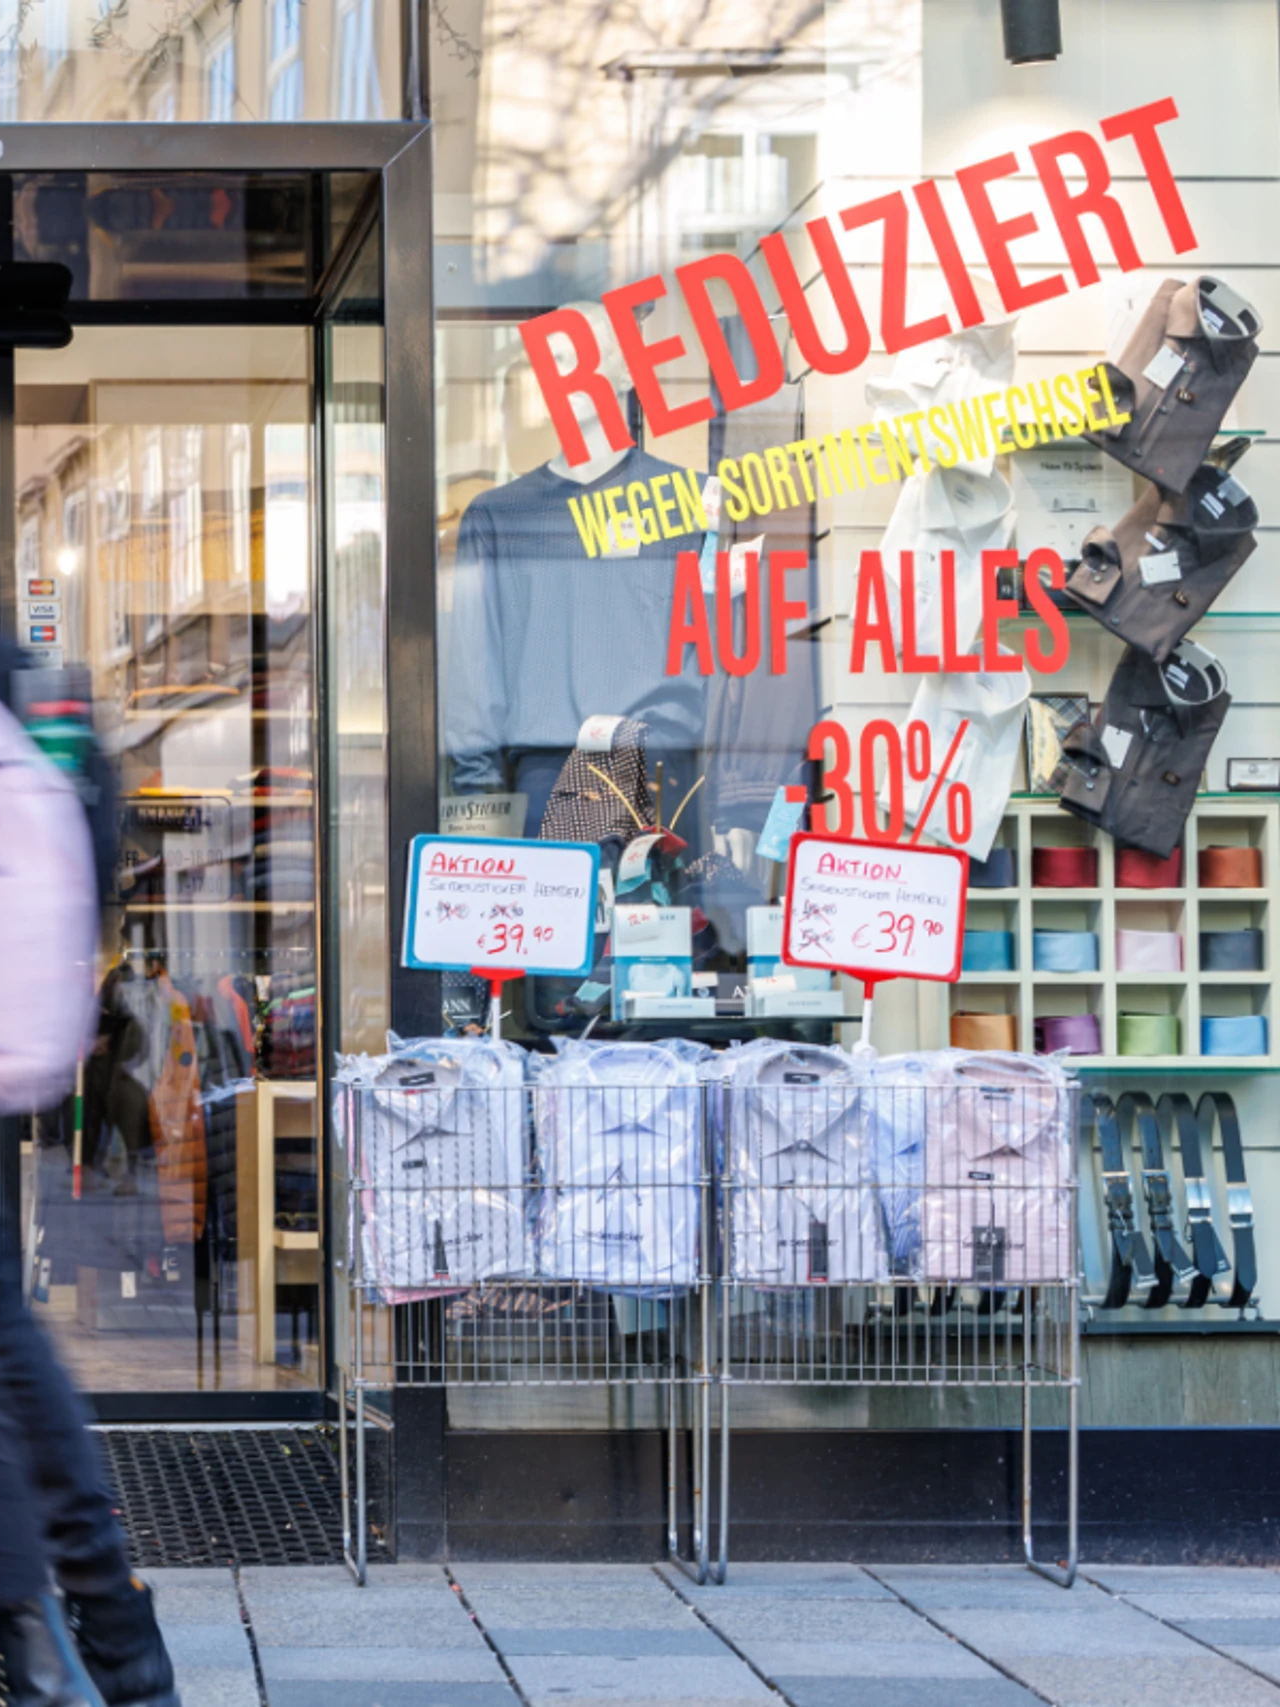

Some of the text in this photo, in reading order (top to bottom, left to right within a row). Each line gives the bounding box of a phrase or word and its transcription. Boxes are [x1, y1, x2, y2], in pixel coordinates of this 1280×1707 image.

[519, 97, 1198, 467] REDUZIERT
[569, 366, 1131, 559] WEGEN SORTIMENTSWECHSEL
[666, 549, 1069, 676] AUF ALLES
[785, 719, 972, 845] -30%
[430, 851, 515, 874] AKTION
[817, 852, 902, 881] AKTION
